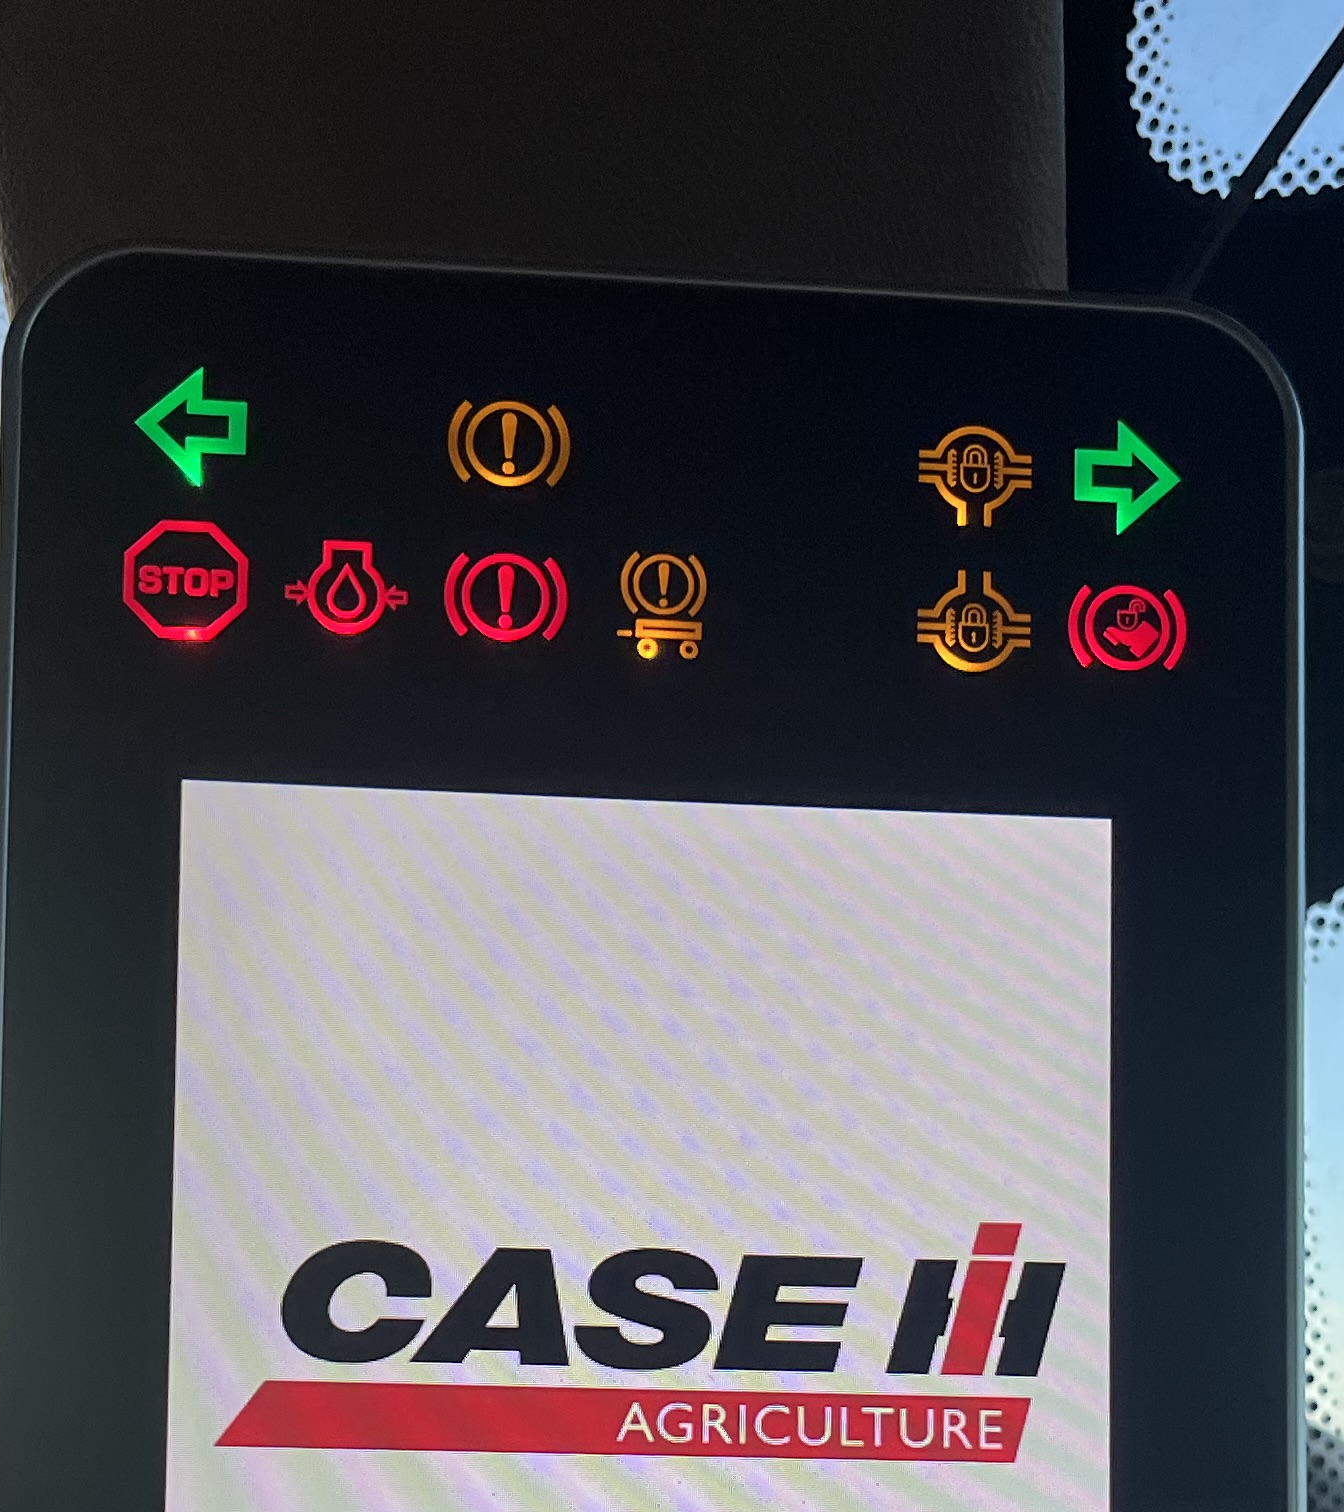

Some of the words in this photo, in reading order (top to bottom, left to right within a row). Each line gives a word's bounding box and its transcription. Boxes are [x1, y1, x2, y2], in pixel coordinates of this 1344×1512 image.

[137, 563, 236, 599] STOP
[280, 1239, 864, 1373] CASE
[615, 1401, 1005, 1451] AGRICULTURE
